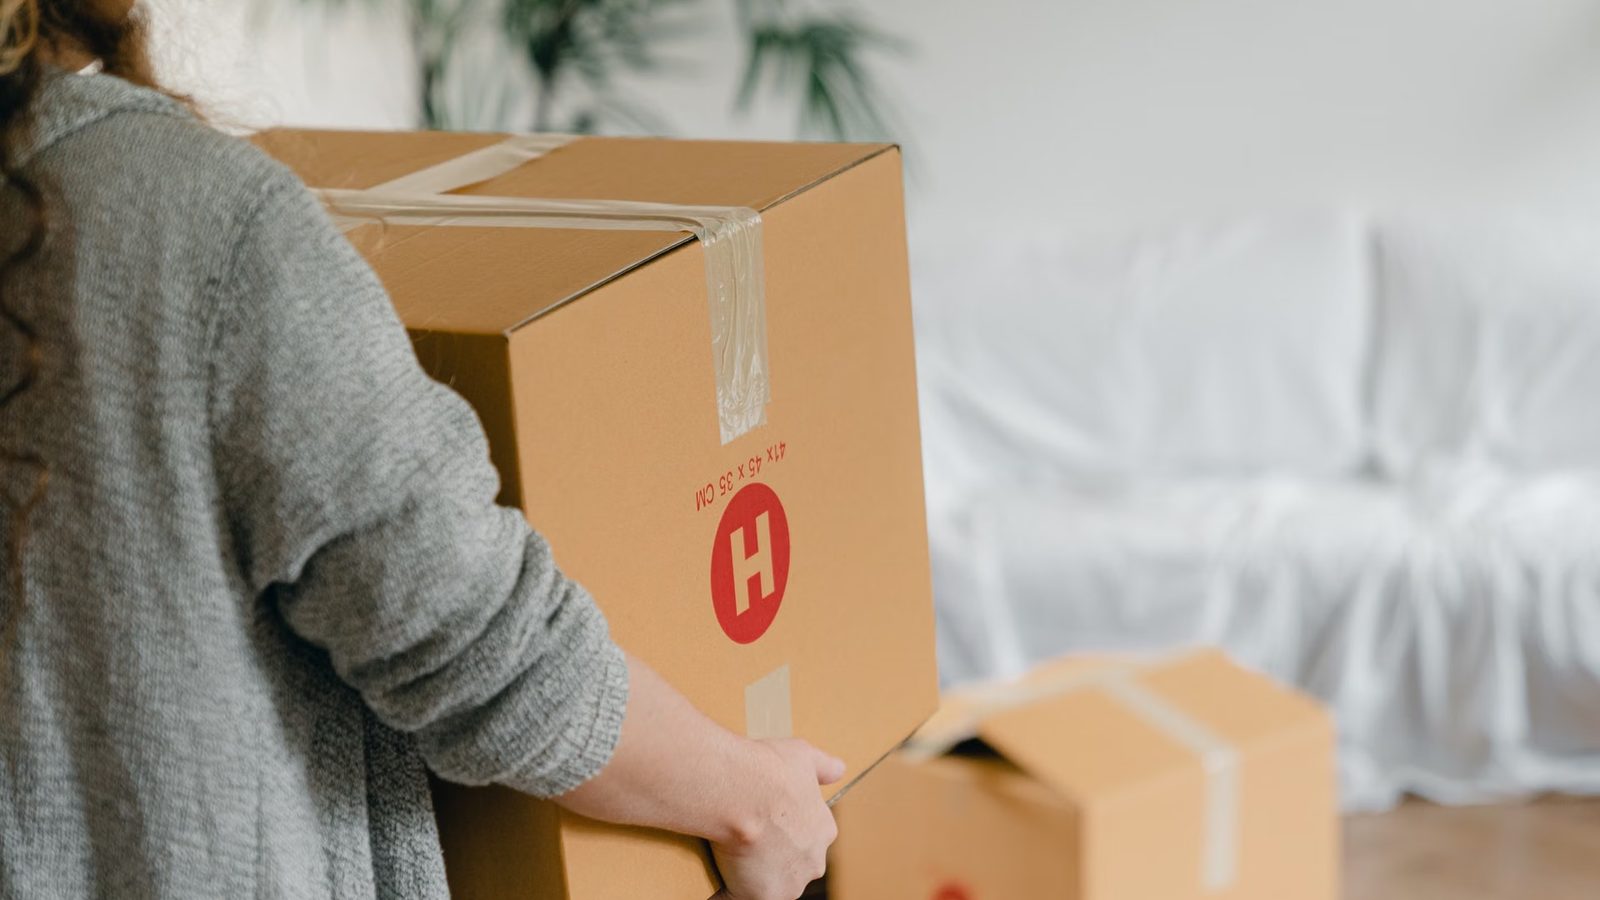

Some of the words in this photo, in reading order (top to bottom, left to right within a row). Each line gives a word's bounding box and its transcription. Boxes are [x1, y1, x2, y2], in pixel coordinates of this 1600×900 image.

[748, 455, 762, 477] 45
[719, 471, 733, 496] 35
[695, 483, 714, 512] CM
[730, 510, 776, 617] H
